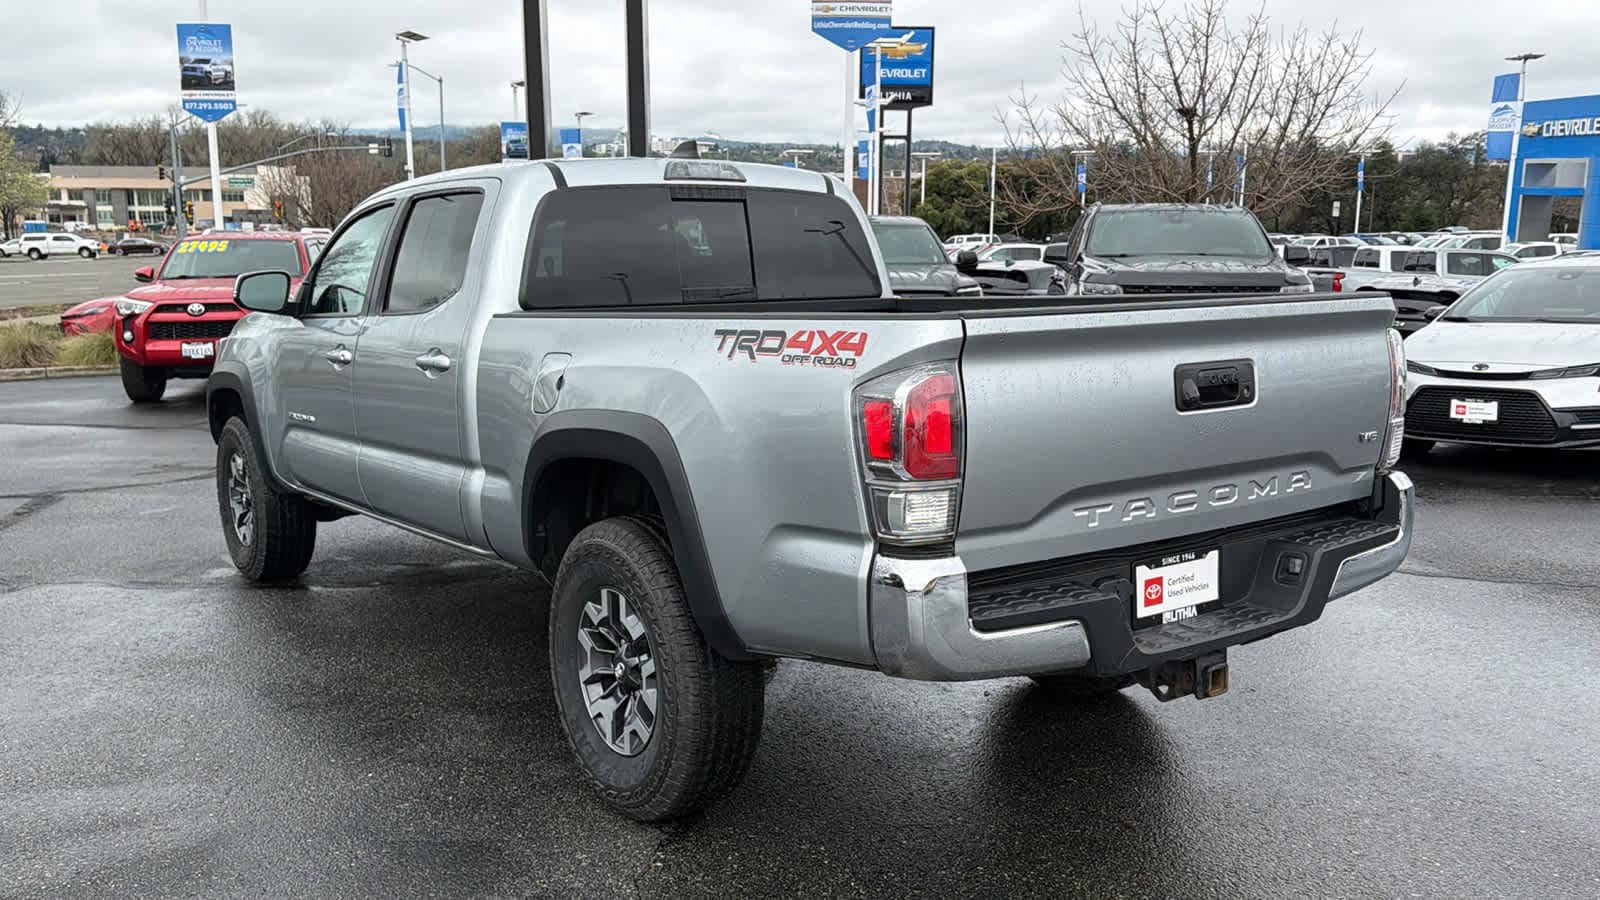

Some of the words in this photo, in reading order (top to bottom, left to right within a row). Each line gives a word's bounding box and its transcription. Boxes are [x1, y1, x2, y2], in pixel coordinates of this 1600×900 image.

[839, 5, 888, 13] CHEVROLET
[881, 68, 927, 78] EVROLET
[1542, 118, 1600, 137] CHEVROLE
[714, 329, 787, 361] TRD
[781, 354, 812, 364] OFF
[812, 356, 857, 368] ROAD
[1073, 470, 1313, 528] TACOMA
[1161, 555, 1180, 565] SINCE
[1167, 574, 1195, 586] Certified
[1167, 589, 1184, 597] Used
[1184, 583, 1209, 593] Vehicles
